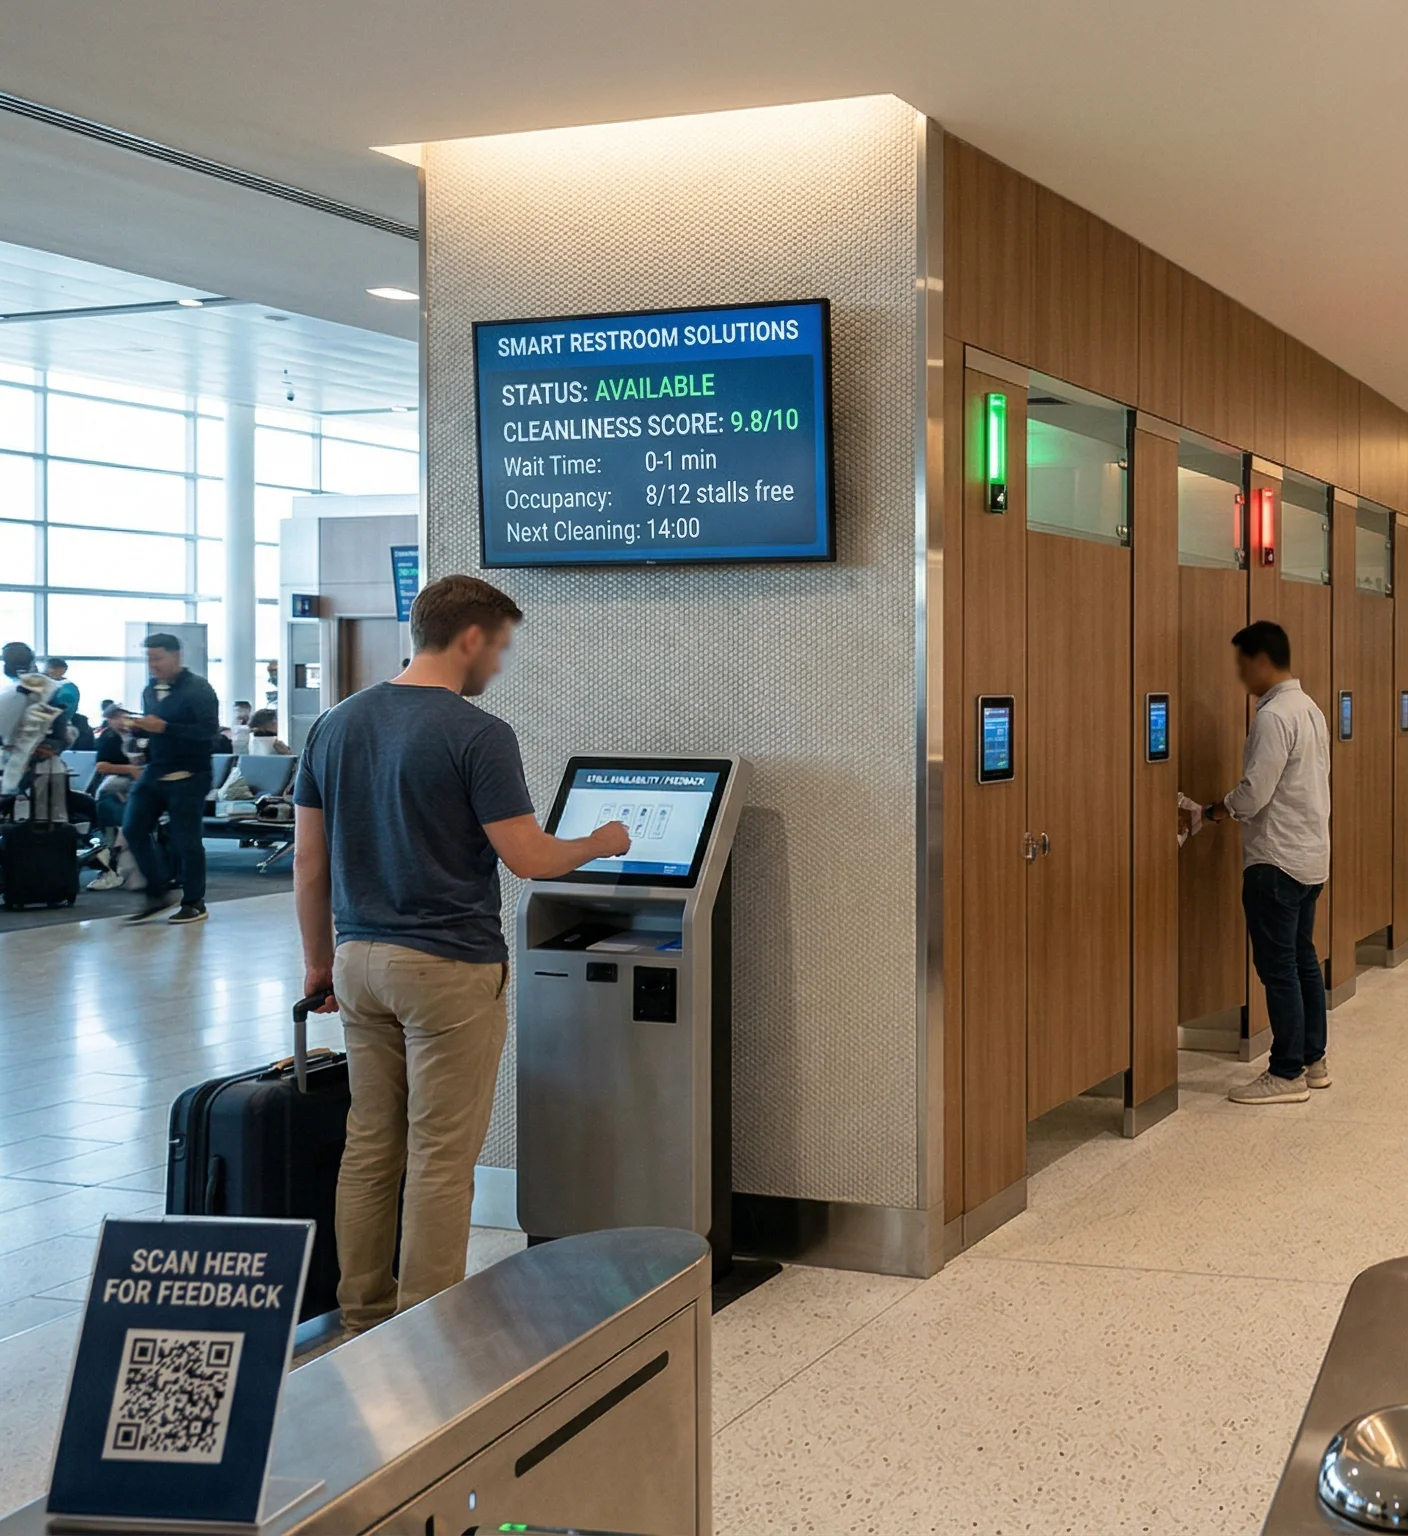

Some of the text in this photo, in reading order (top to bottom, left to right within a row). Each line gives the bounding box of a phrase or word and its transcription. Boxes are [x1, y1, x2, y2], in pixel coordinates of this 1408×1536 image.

[498, 319, 800, 357] SMART RESTROOM SOLUTIONS
[501, 373, 715, 407] STATUS: AVAILABLE
[503, 408, 799, 443] CLEANLINESS SCORE: 9.8/10
[504, 448, 717, 477] Wait Time: 0-1 min
[505, 479, 795, 514] Occupancy: 8/12 stalls free
[506, 517, 701, 545] Next Cleaning: 14:00
[131, 1248, 268, 1277] SCAN HERE
[103, 1278, 284, 1309] FOR FEEDBACK
